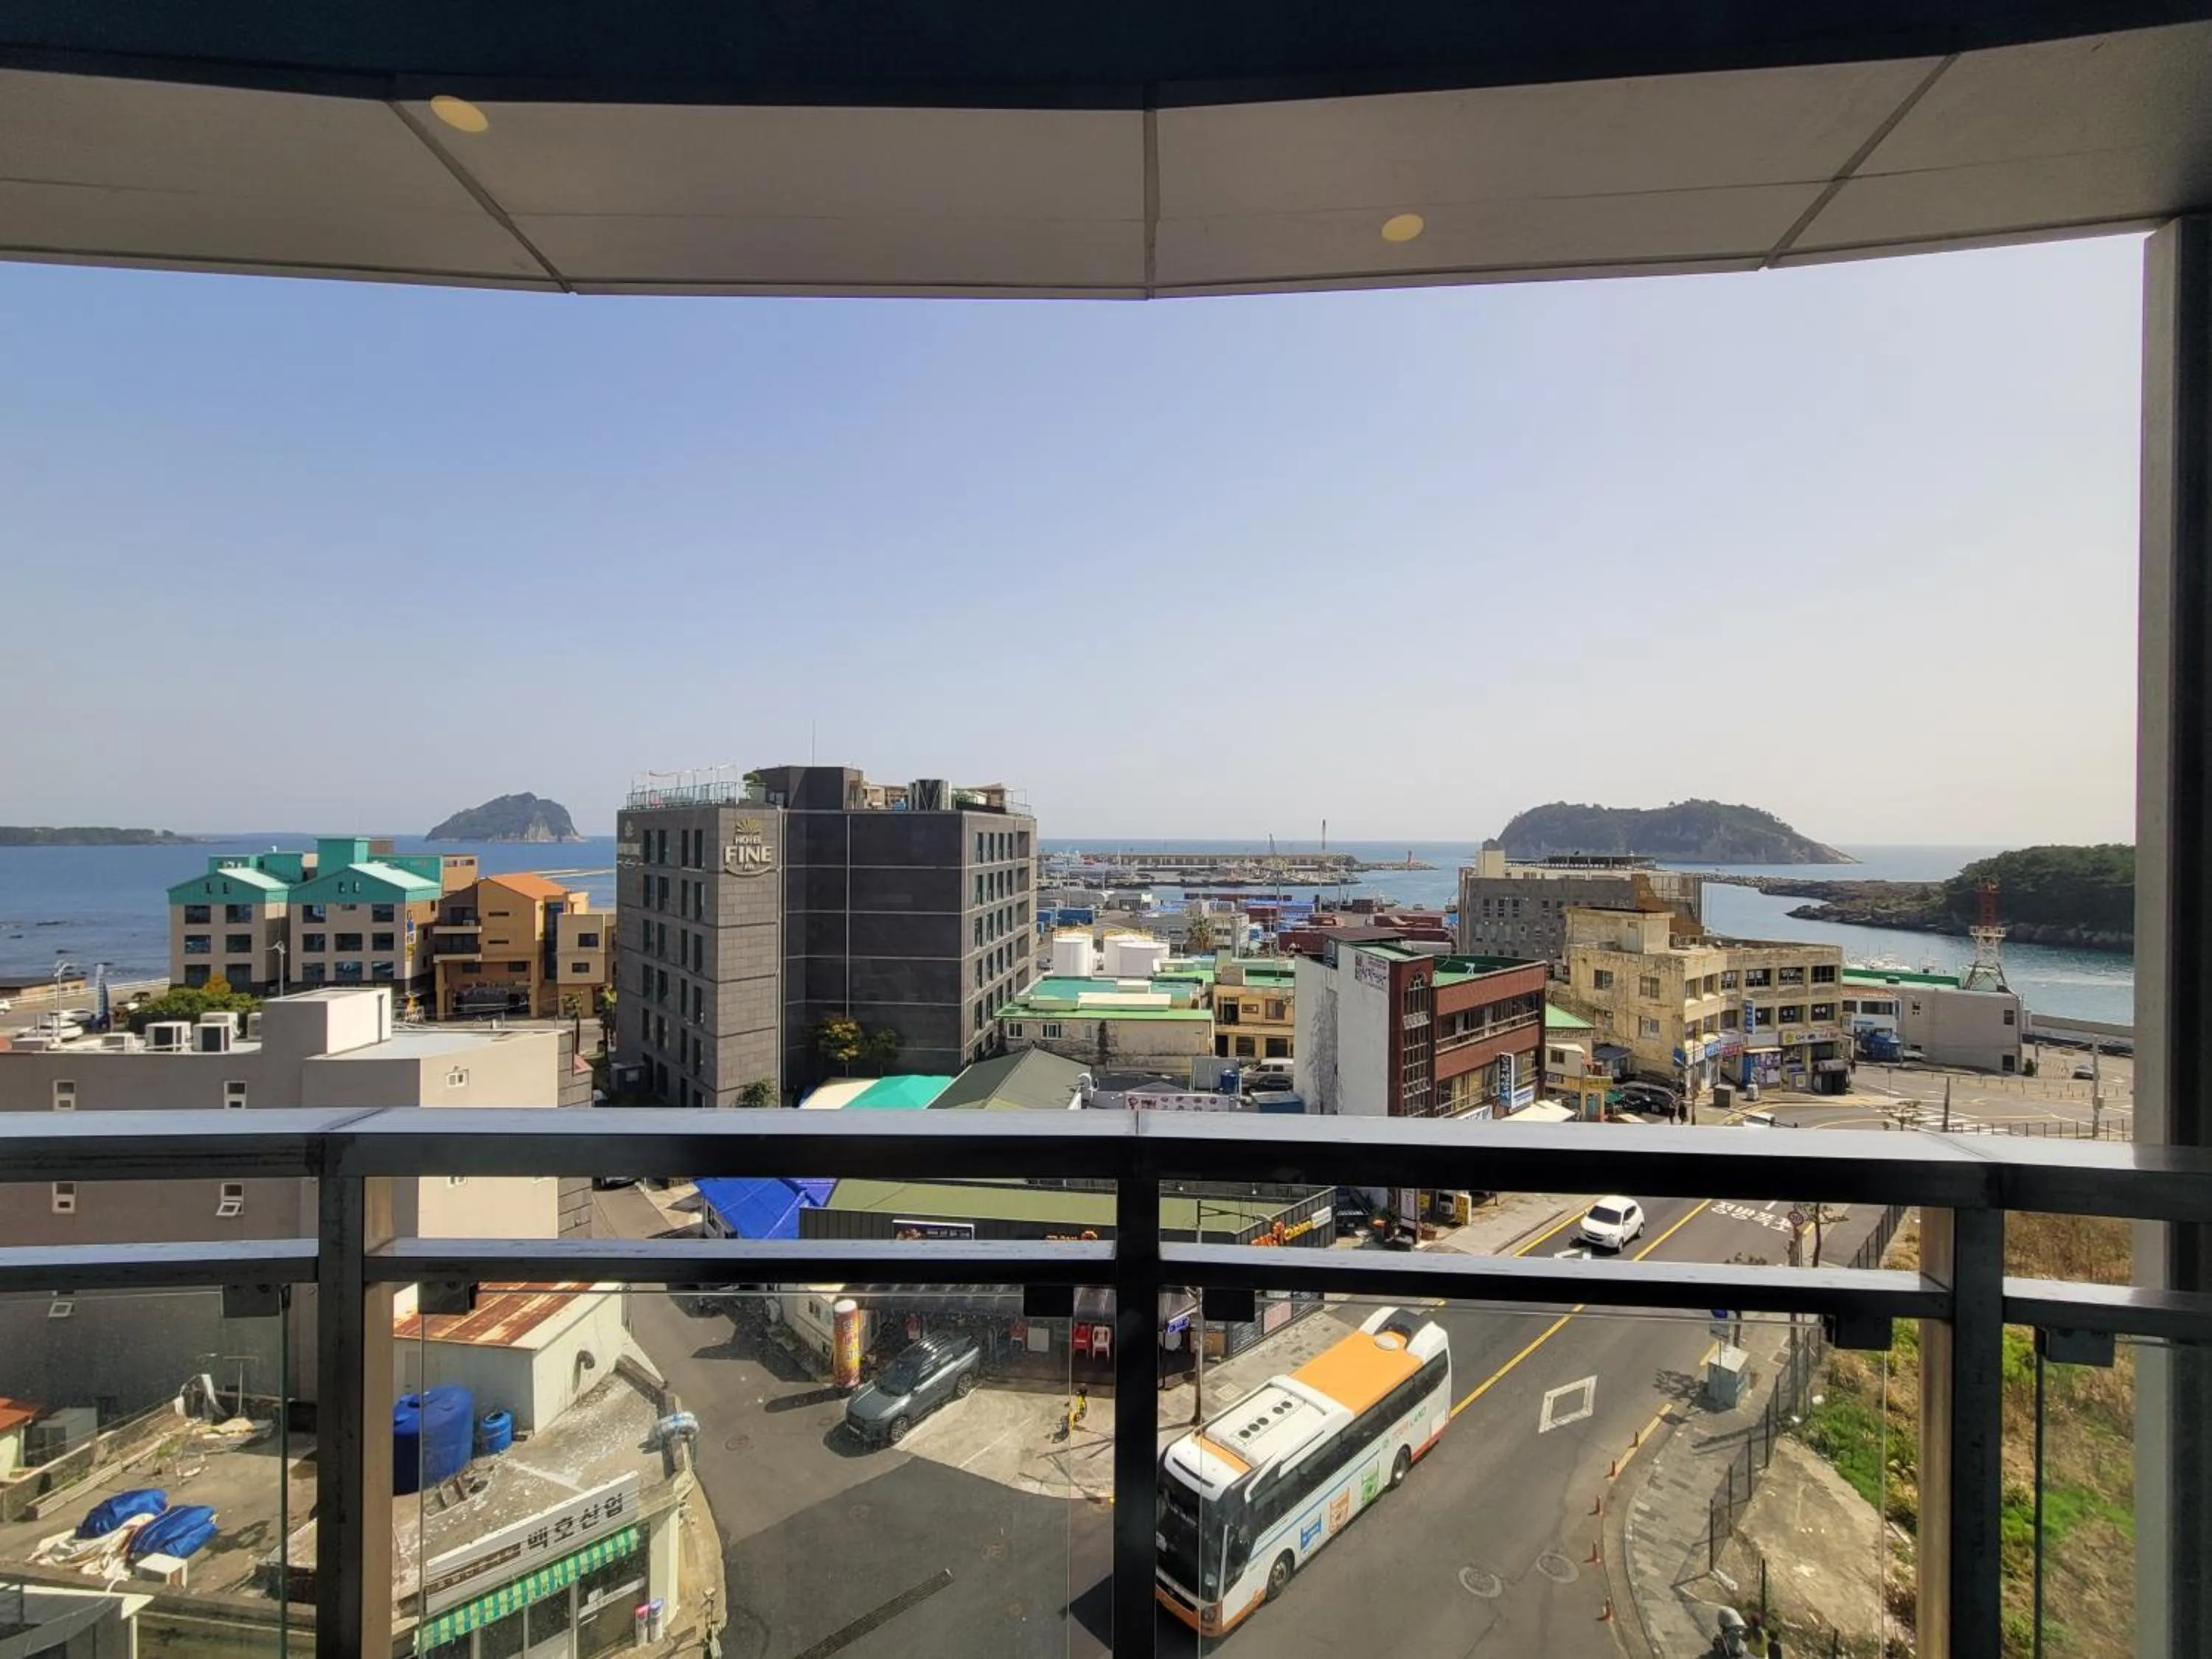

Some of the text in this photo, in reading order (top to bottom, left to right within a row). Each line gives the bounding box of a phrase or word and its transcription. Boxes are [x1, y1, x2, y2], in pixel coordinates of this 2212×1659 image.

[735, 835, 762, 844] HOTEL
[725, 846, 773, 863] FINE
[1711, 1201, 1792, 1232] 정방폭포
[527, 1492, 623, 1550] 백호산업
